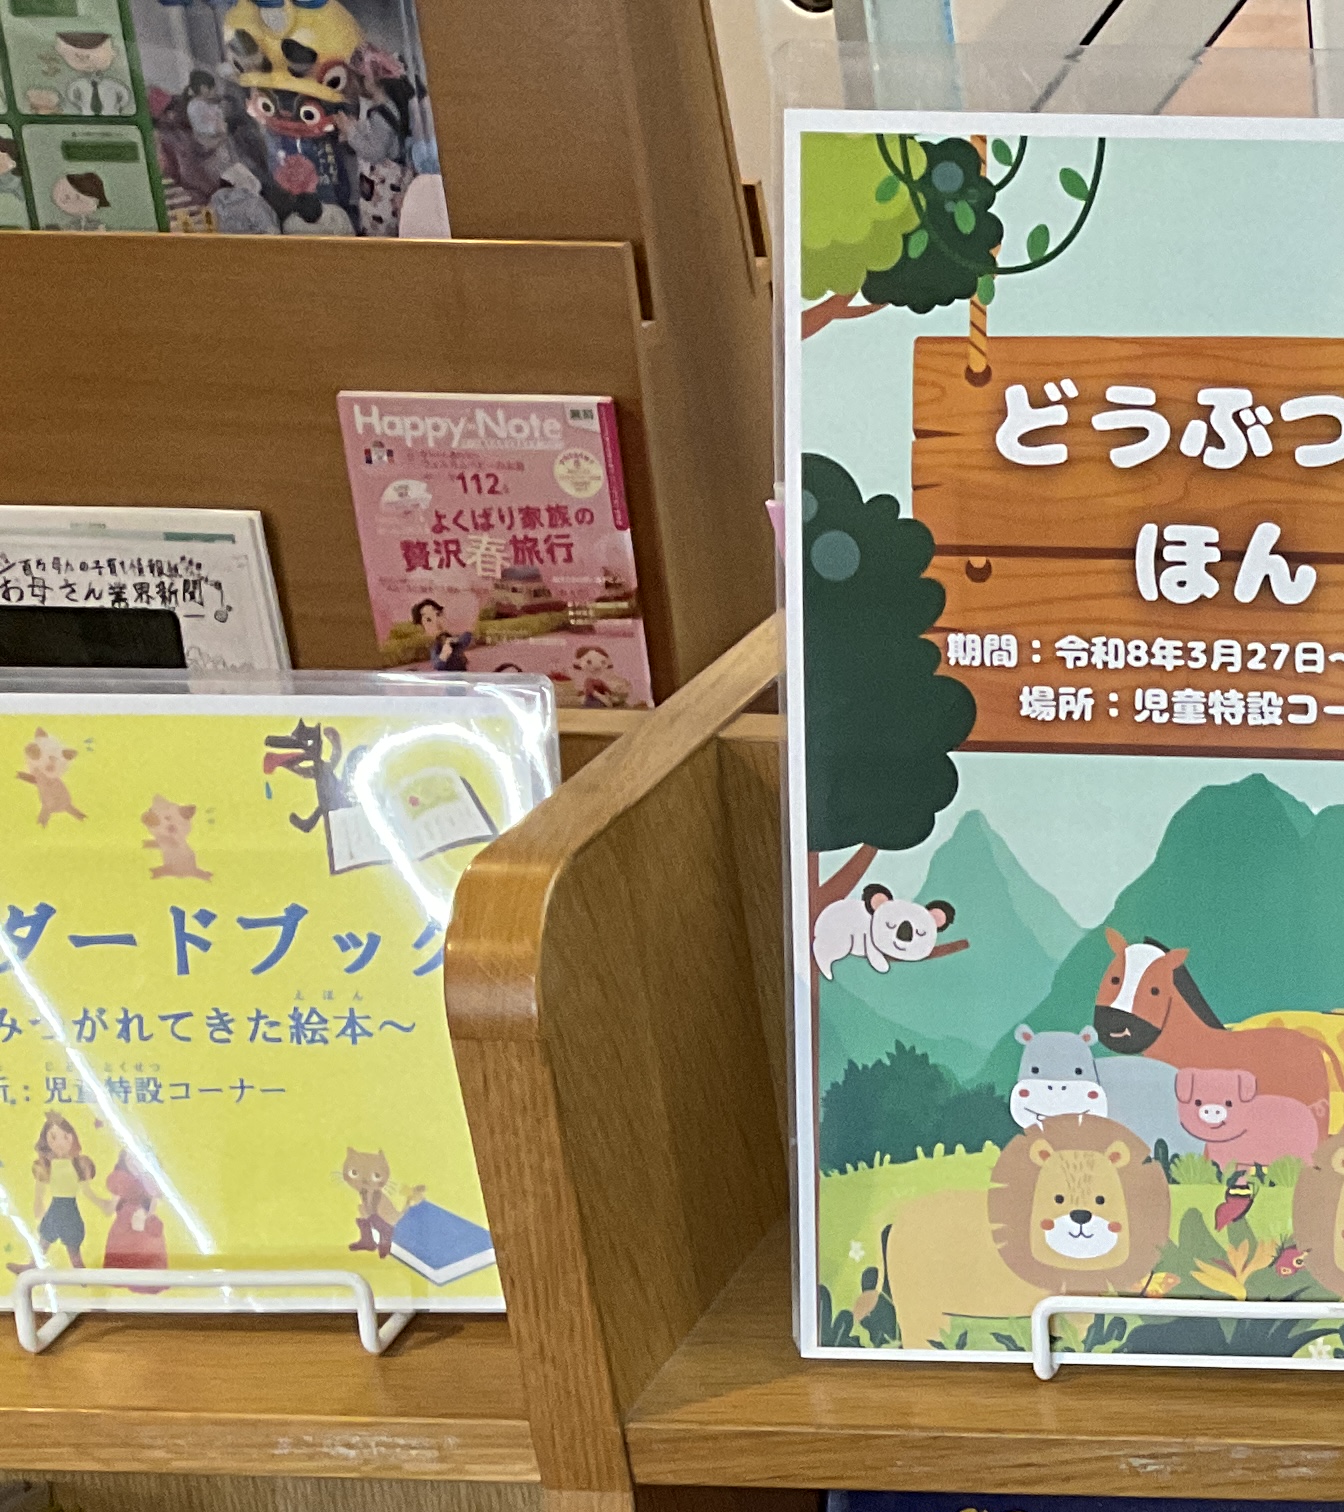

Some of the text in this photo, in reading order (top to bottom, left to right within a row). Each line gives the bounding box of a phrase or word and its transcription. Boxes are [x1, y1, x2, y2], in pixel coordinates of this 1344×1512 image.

[457, 471, 500, 495] 112
[431, 504, 595, 534] よくばり家族の
[1134, 521, 1318, 606] ほん
